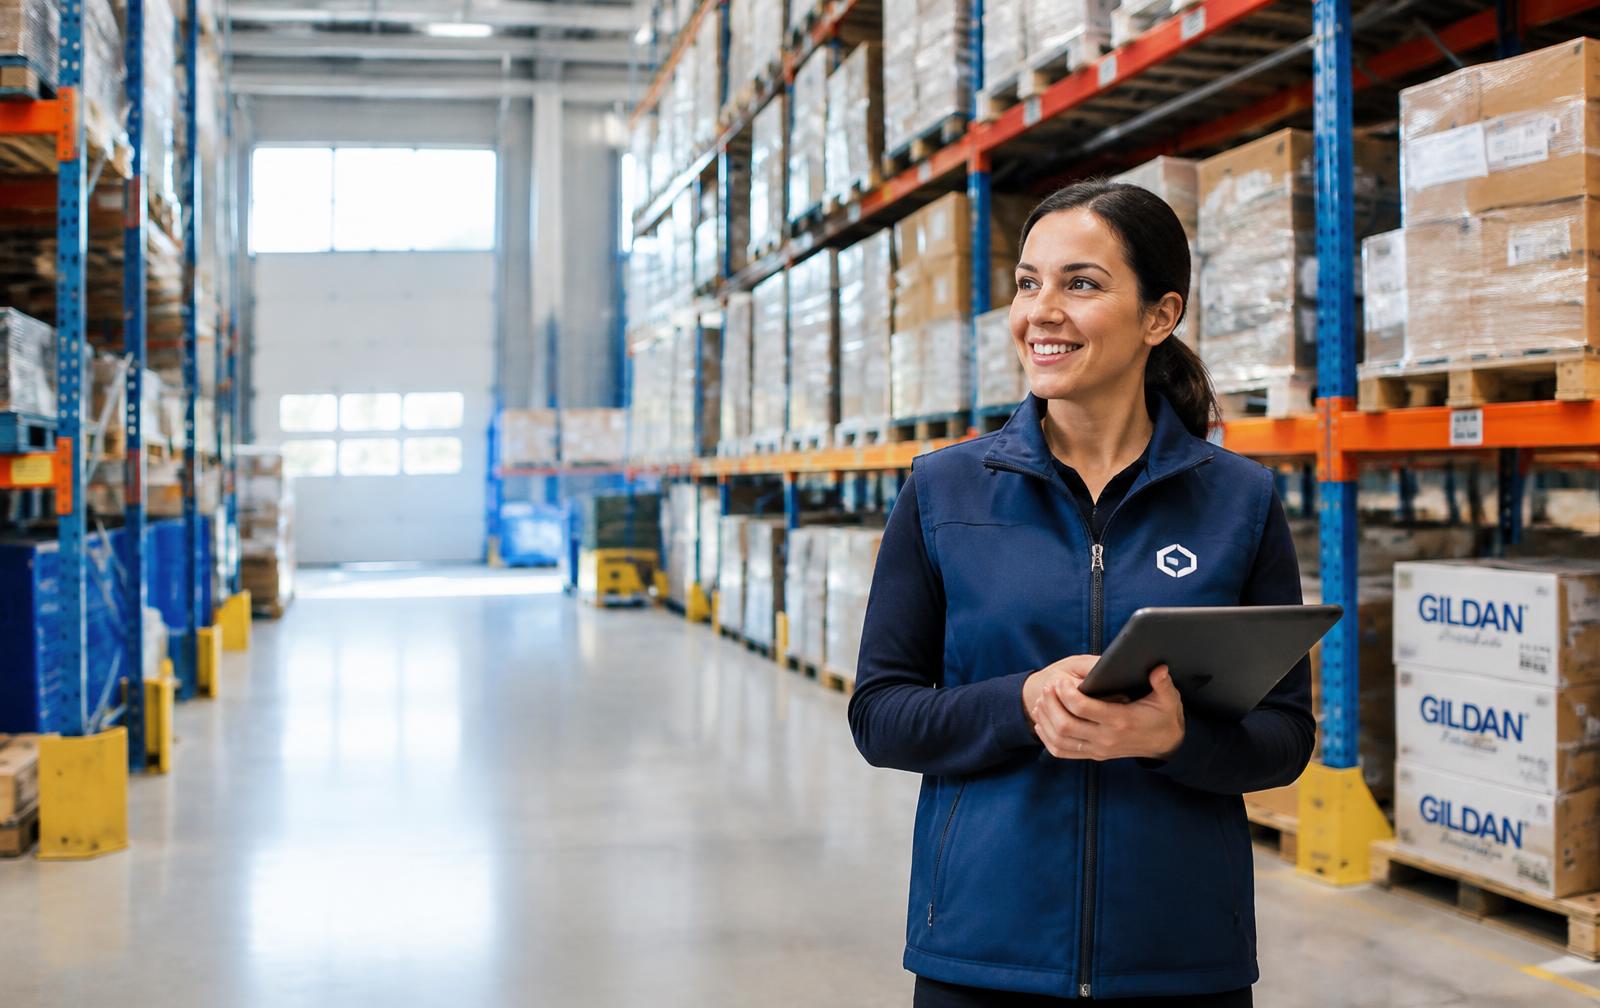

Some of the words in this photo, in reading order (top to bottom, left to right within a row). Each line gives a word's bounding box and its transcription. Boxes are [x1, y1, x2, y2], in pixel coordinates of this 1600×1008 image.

[1418, 594, 1523, 633] GILDAN
[1420, 695, 1523, 742] GILDAN
[1420, 795, 1522, 849] GILDAN
